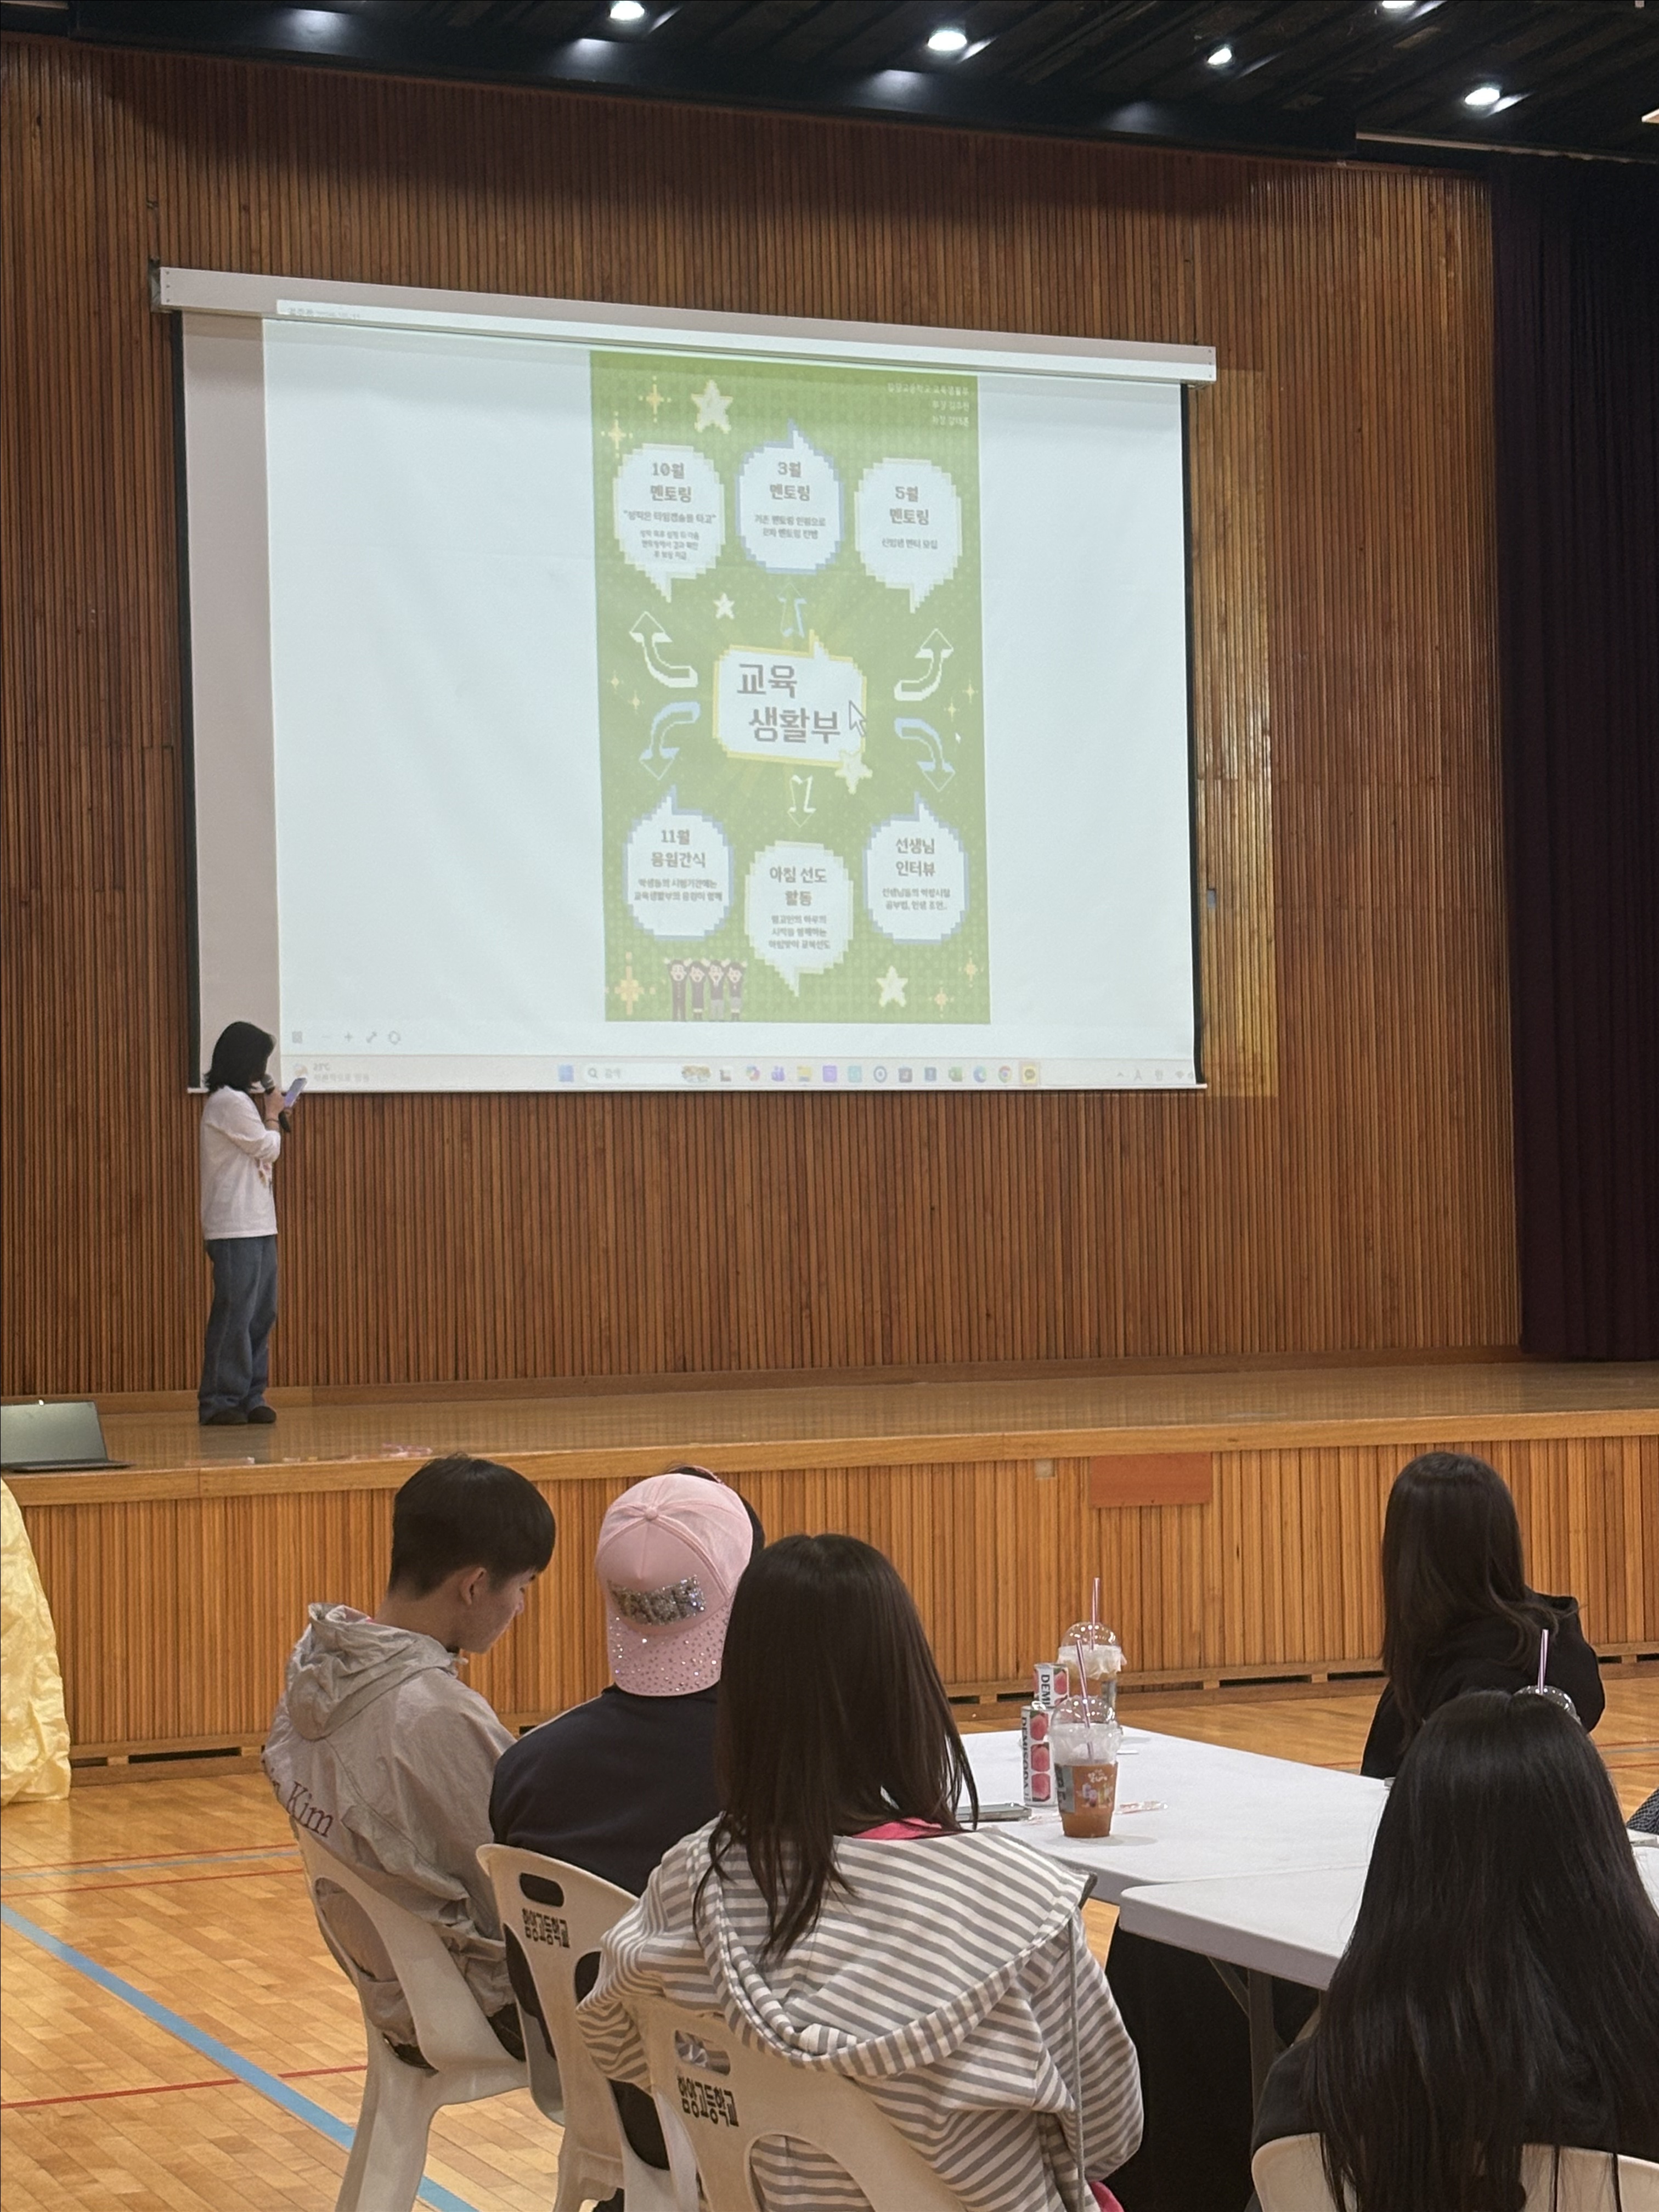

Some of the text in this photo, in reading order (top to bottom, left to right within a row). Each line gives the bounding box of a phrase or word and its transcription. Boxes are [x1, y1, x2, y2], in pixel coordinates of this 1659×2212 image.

[652, 462, 685, 479] 10월
[777, 461, 802, 478] 3월
[650, 484, 692, 503] 멘토링
[770, 483, 810, 502] 멘토링
[895, 486, 919, 503] 5월
[889, 508, 929, 526] 멘토링
[737, 663, 798, 699] 교육
[748, 707, 841, 744] 생활부
[661, 829, 690, 845] 11월
[895, 837, 935, 854] 선생님
[651, 851, 706, 868] 응원간식
[769, 865, 828, 884] 아침 선도
[895, 860, 936, 877] 인터뷰
[785, 889, 812, 906] 활동
[283, 1781, 334, 1838] Kim
